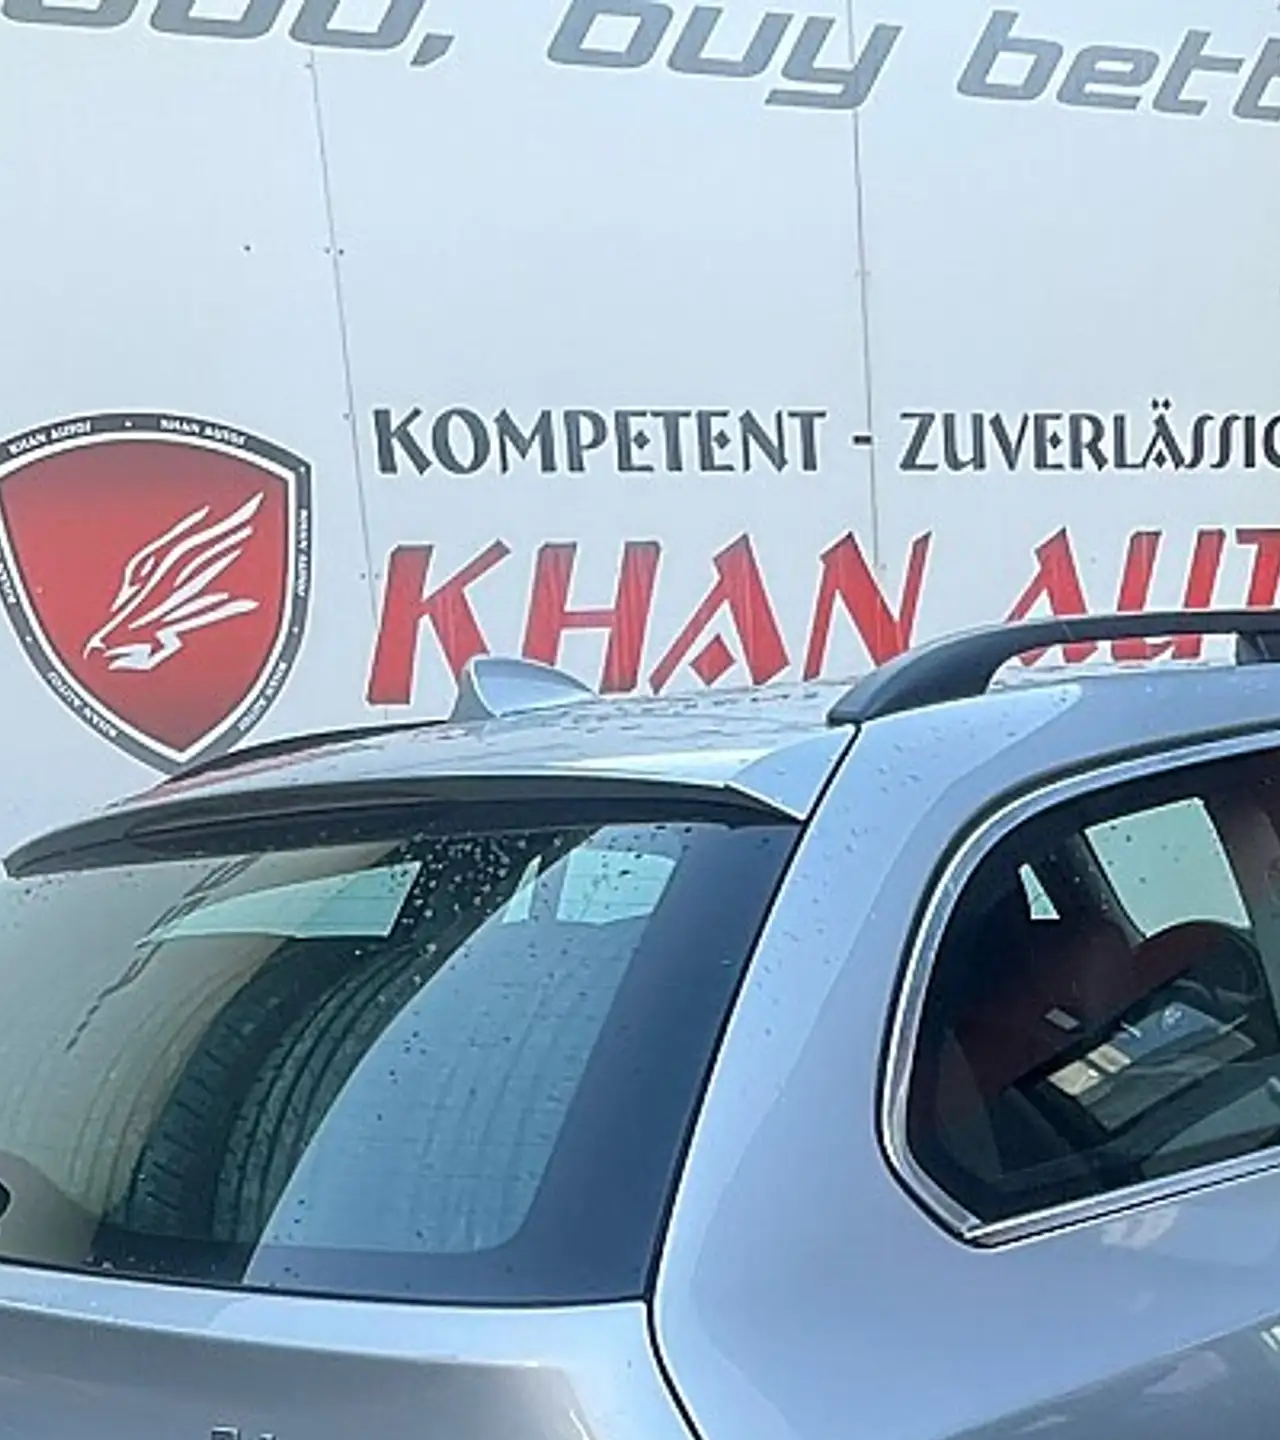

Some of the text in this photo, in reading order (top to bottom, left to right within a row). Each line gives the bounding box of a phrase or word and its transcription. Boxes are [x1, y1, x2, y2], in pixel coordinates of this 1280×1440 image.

[547, 0, 902, 109] buy
[374, 407, 827, 476] KOMPETENT
[366, 531, 933, 705] KHAN
